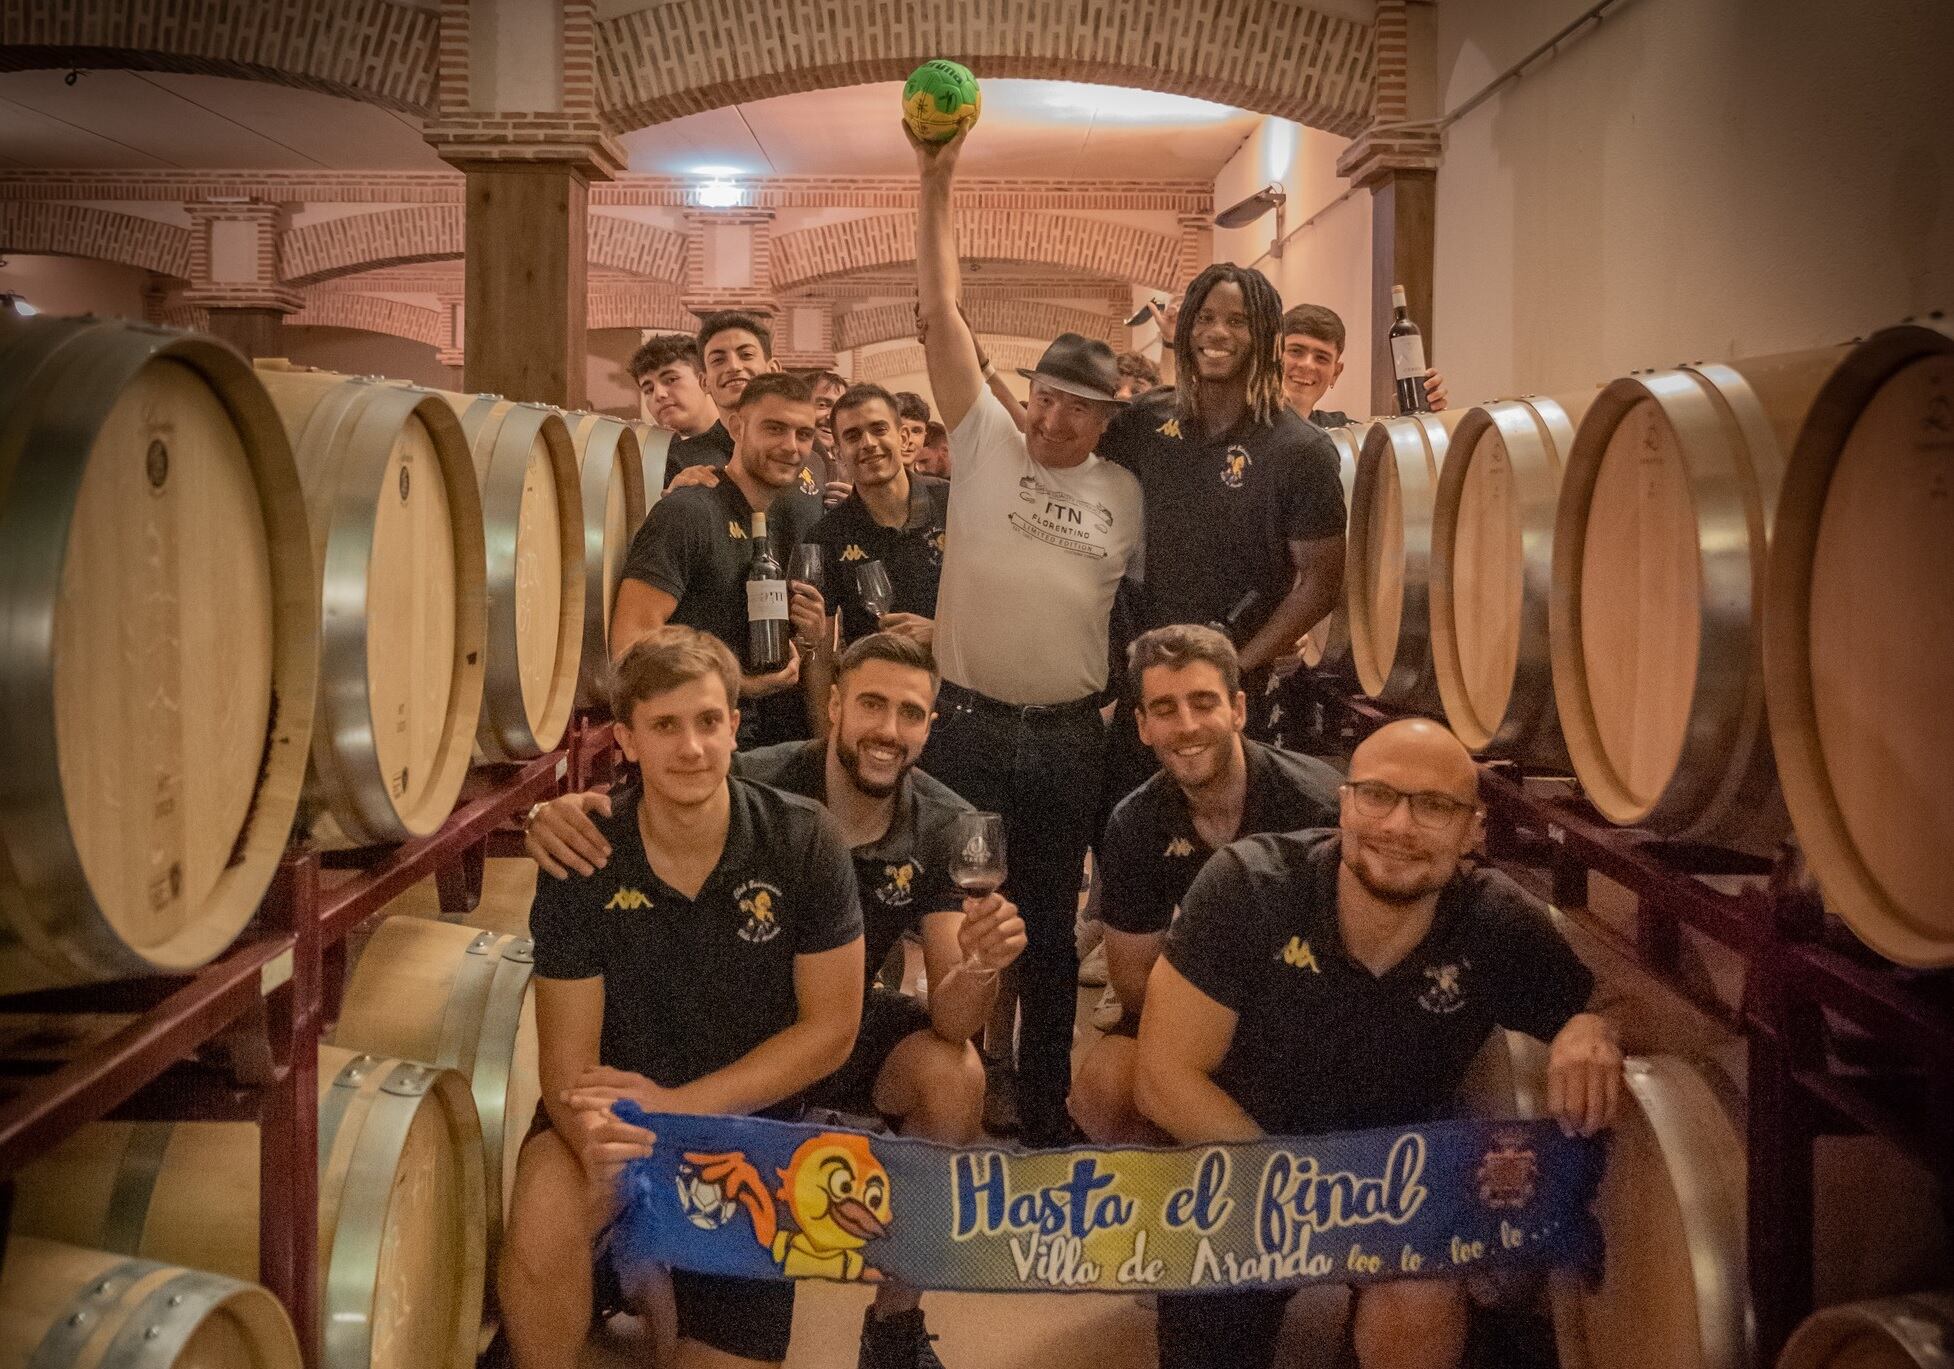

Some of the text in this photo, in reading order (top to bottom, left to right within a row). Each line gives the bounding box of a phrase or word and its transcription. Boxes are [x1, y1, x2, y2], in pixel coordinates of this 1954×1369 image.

[1023, 523, 1056, 542] LIMITED
[1059, 539, 1093, 552] EDITION
[1032, 513, 1090, 539] FLORENTINO
[953, 1134, 1426, 1256] Hasta el final
[1010, 1232, 1101, 1286] Villa
[1117, 1230, 1166, 1283] de
[1190, 1223, 1333, 1286] Aranda
